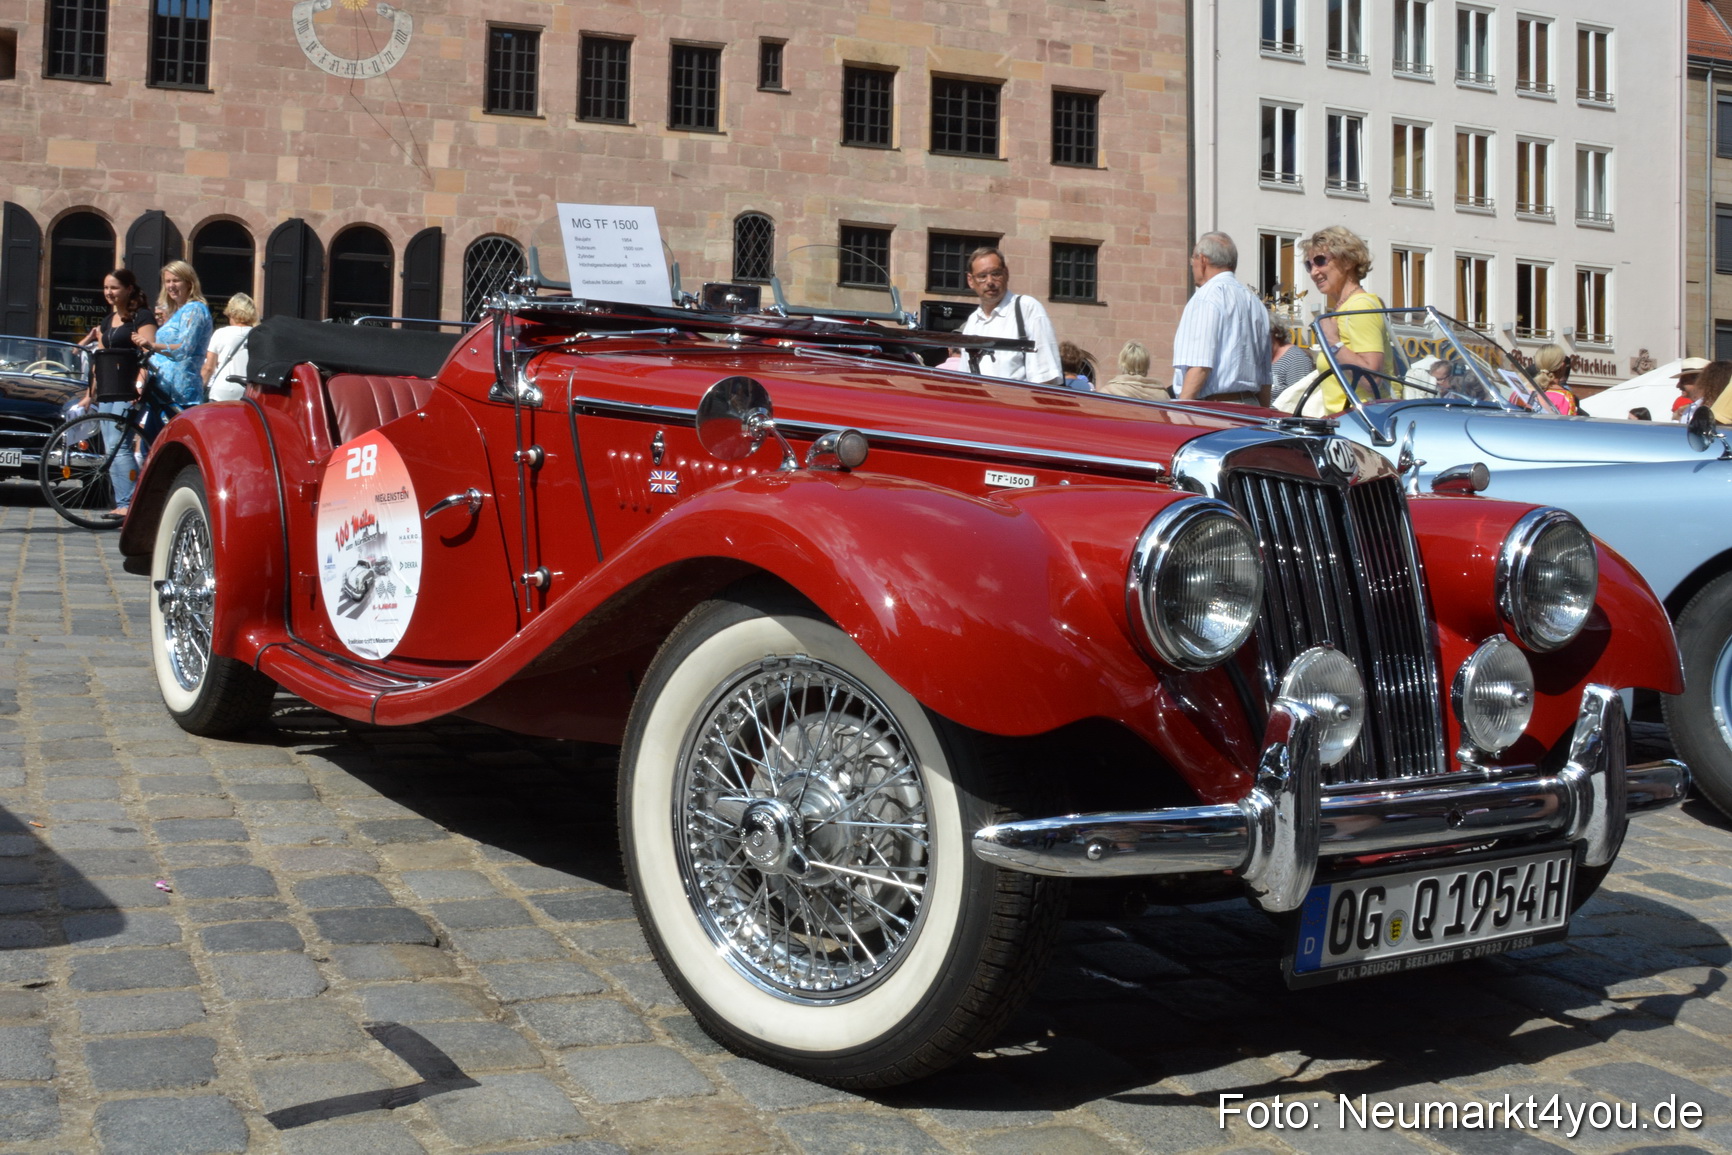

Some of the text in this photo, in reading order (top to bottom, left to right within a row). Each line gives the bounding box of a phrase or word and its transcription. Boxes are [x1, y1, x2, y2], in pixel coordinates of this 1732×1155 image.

[571, 218, 639, 230] MG TF 1500
[346, 444, 378, 480] 28
[1333, 441, 1356, 469] MG
[335, 519, 350, 552] 100
[404, 561, 418, 569] DEKRA
[1329, 886, 1386, 955] OG
[1304, 936, 1315, 955] D
[1360, 959, 1401, 978] DEUSCH
[1405, 950, 1455, 969] SEELBACH
